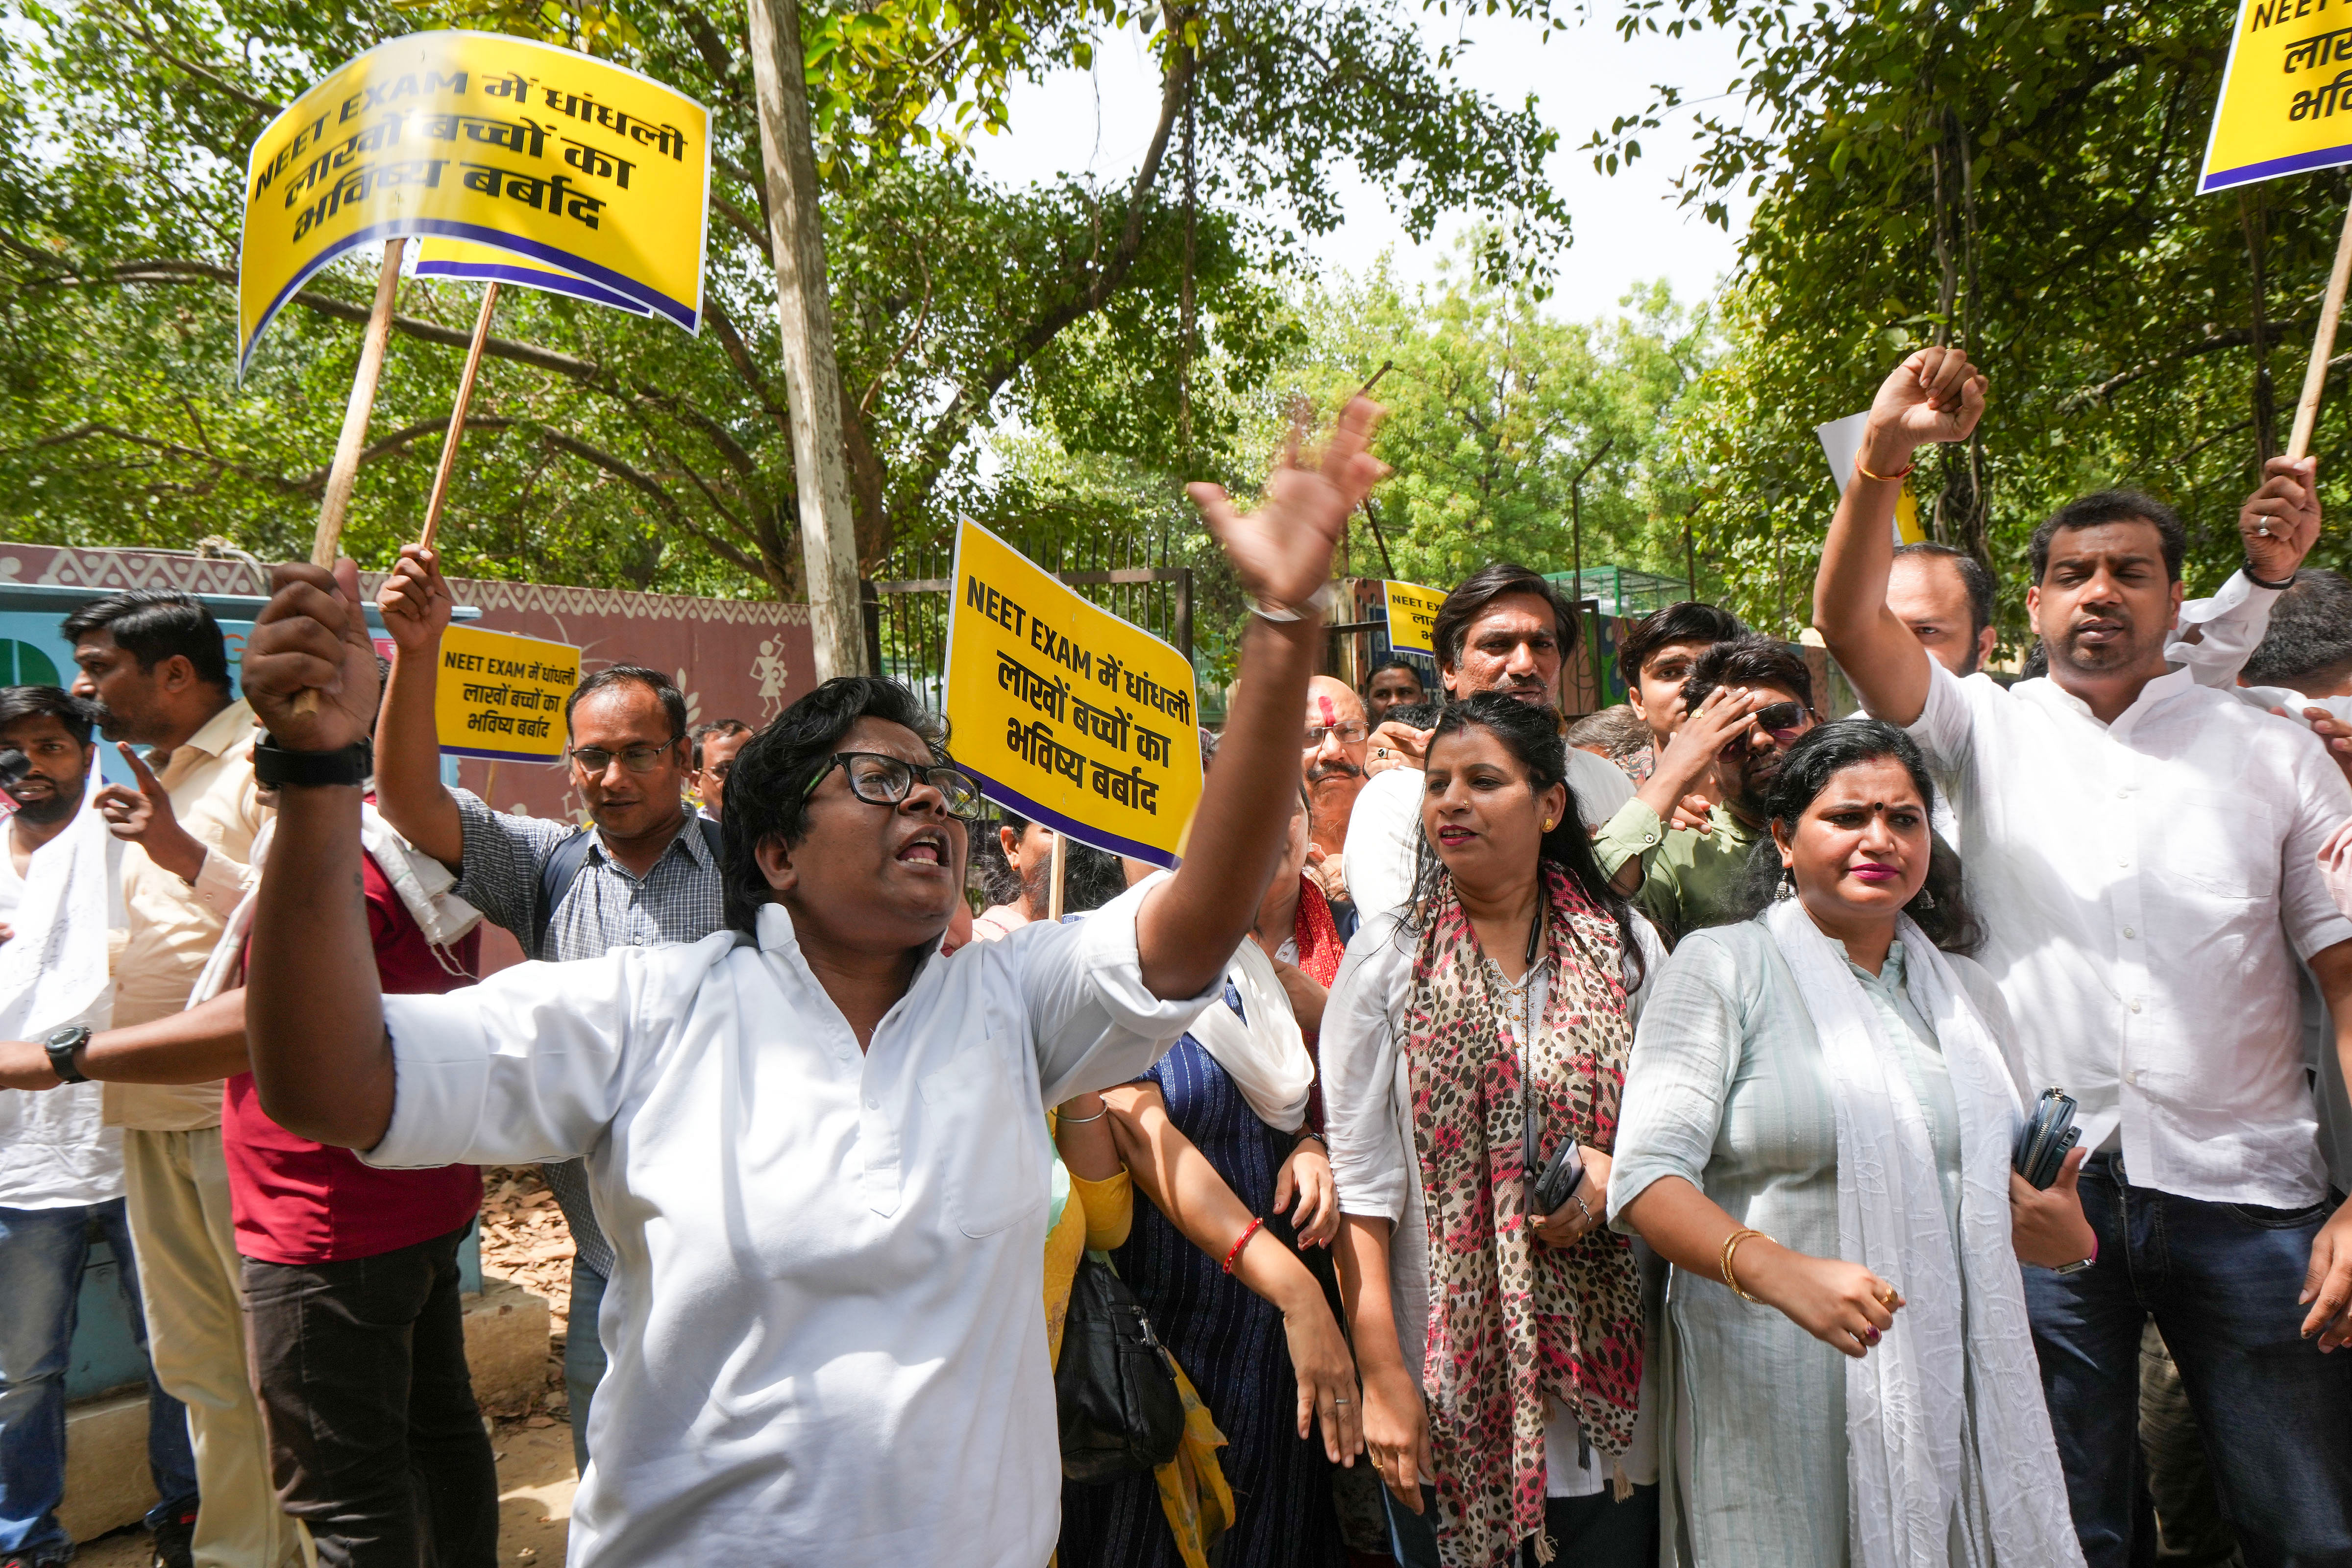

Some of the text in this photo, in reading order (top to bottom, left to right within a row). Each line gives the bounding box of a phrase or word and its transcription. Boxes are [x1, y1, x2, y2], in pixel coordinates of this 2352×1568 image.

[255, 72, 688, 203] NEET EXAM में धांधली
[285, 109, 636, 209] लाखों बच्चों का
[293, 159, 607, 243] भविष्य बर्बाद
[1392, 595, 1441, 612] NEET EX
[445, 651, 576, 686] NEET EXAM में धांधली
[967, 575, 1190, 726] NEET EXAM में धांधली
[463, 683, 561, 712] लाखों बच्चों का
[467, 710, 550, 738] भविष्य बर्बाद
[996, 649, 1172, 768] लाखों बच्चों का
[1007, 717, 1159, 815] भविष्य बर्बाद
